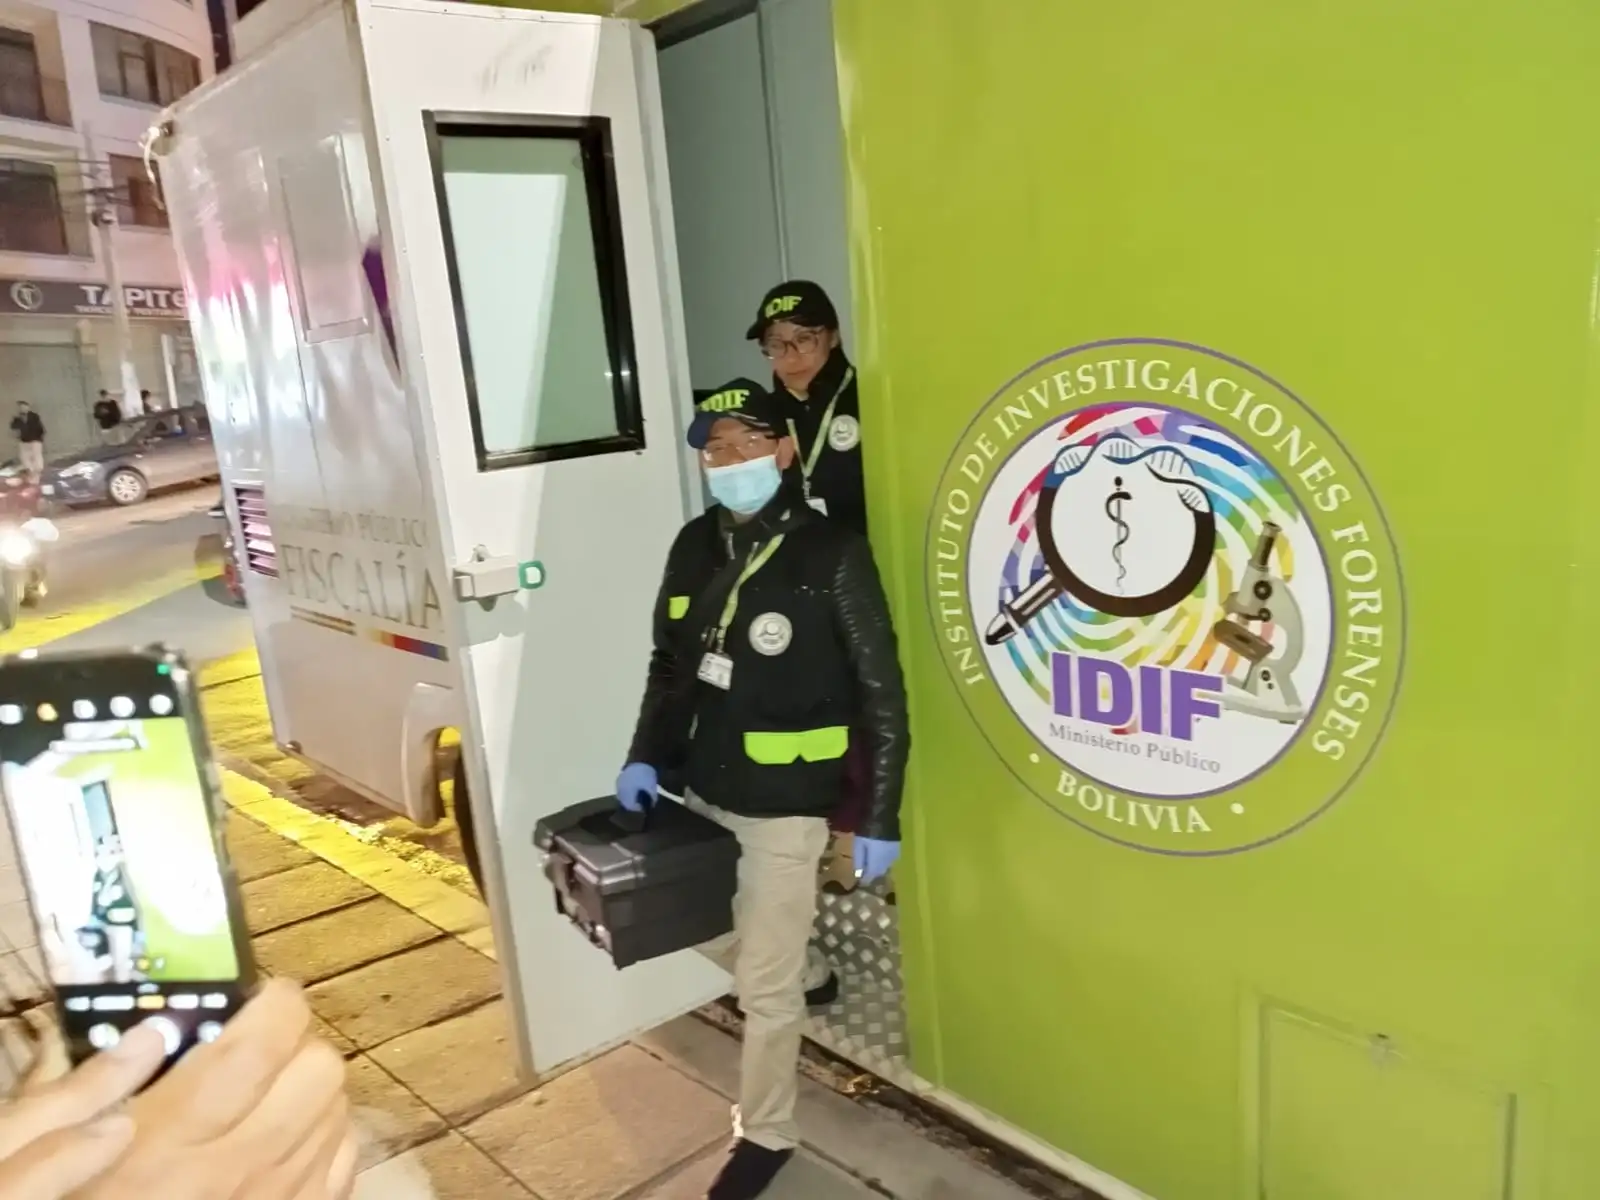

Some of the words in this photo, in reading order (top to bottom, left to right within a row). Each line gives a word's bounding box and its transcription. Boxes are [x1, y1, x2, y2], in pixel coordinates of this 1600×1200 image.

[765, 295, 803, 319] IDIF
[280, 544, 444, 632] FISCALÍA
[936, 488, 985, 686] INSTITUTO
[966, 436, 999, 484] DE
[993, 358, 1351, 513] INVESTIGACIONES
[1311, 521, 1384, 761] FORENSES
[1052, 652, 1223, 741] IDIF
[1049, 722, 1141, 756] Ministerio
[1146, 743, 1221, 774] Público
[1057, 770, 1211, 834] BOLIVIA
